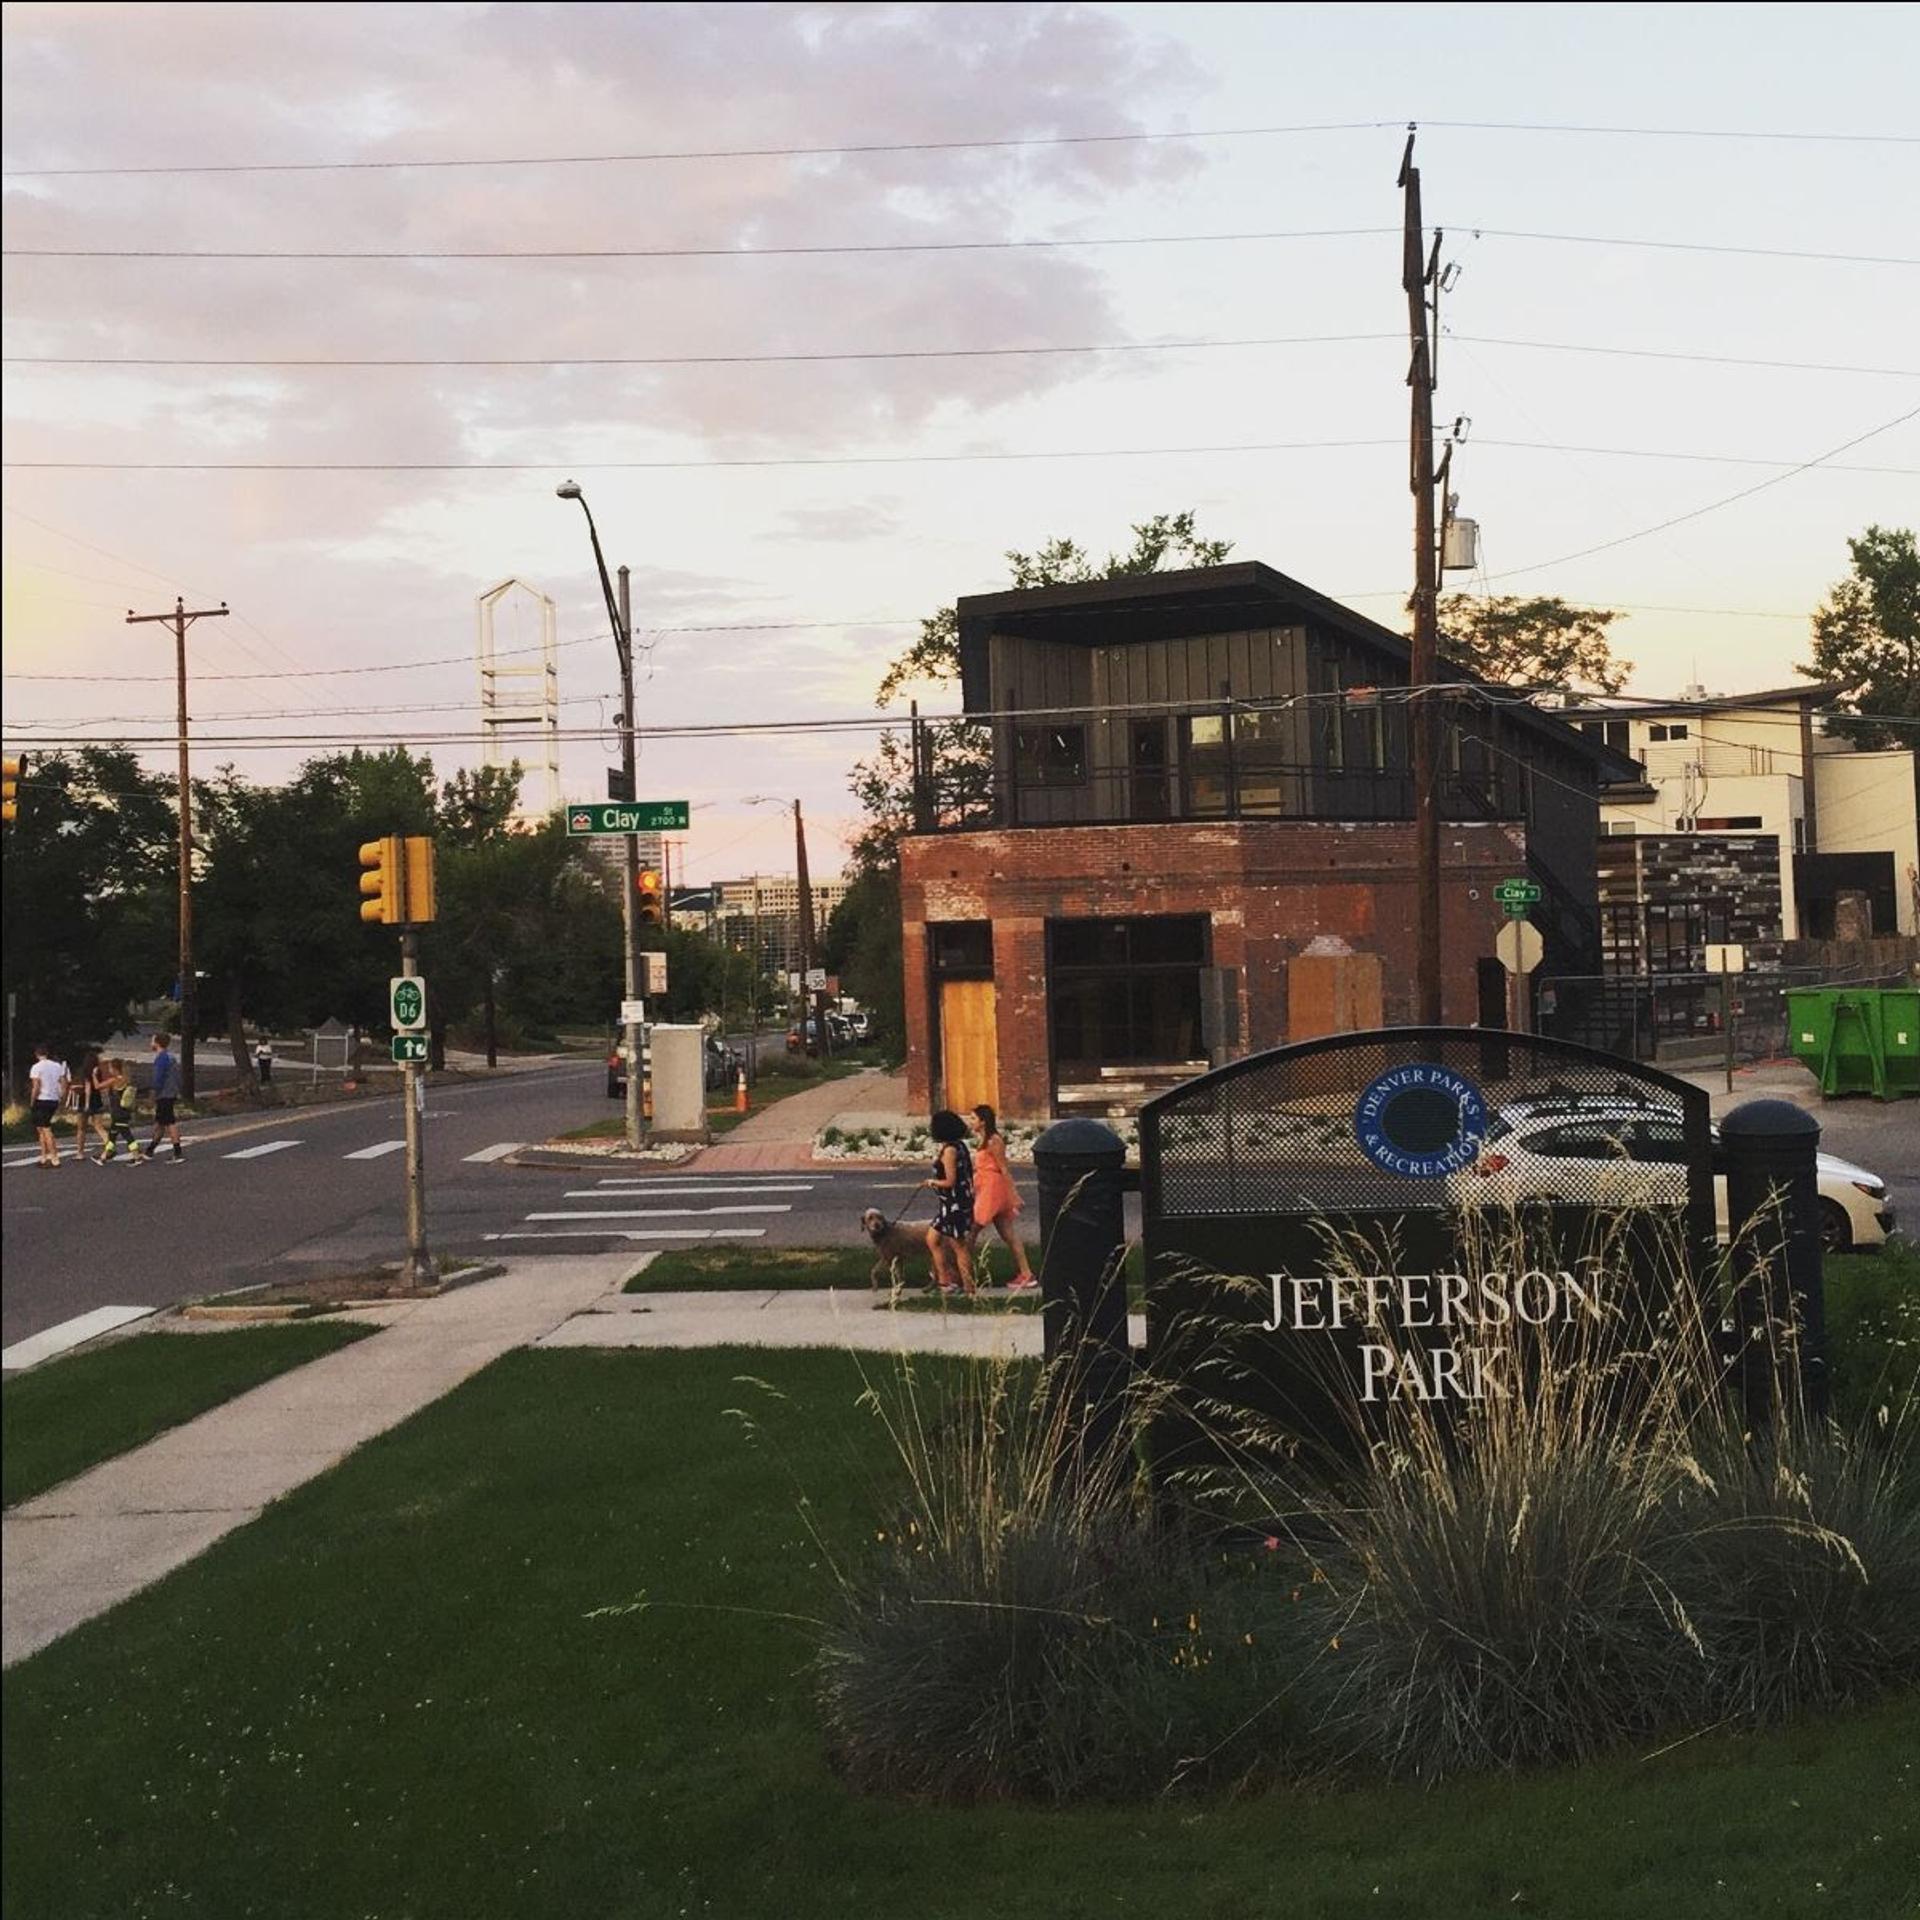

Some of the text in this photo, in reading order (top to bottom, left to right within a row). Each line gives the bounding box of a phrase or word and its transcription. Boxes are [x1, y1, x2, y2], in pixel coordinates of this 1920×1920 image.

[602, 809, 640, 830] Clay
[1503, 887, 1526, 899] Clay
[400, 1002, 417, 1018] D6
[1363, 1069, 1480, 1117] DENVER PARKS
[1365, 1131, 1480, 1175] & RECREATION
[1262, 1270, 1603, 1332] JEFFERSON
[1357, 1345, 1514, 1401] PARK
